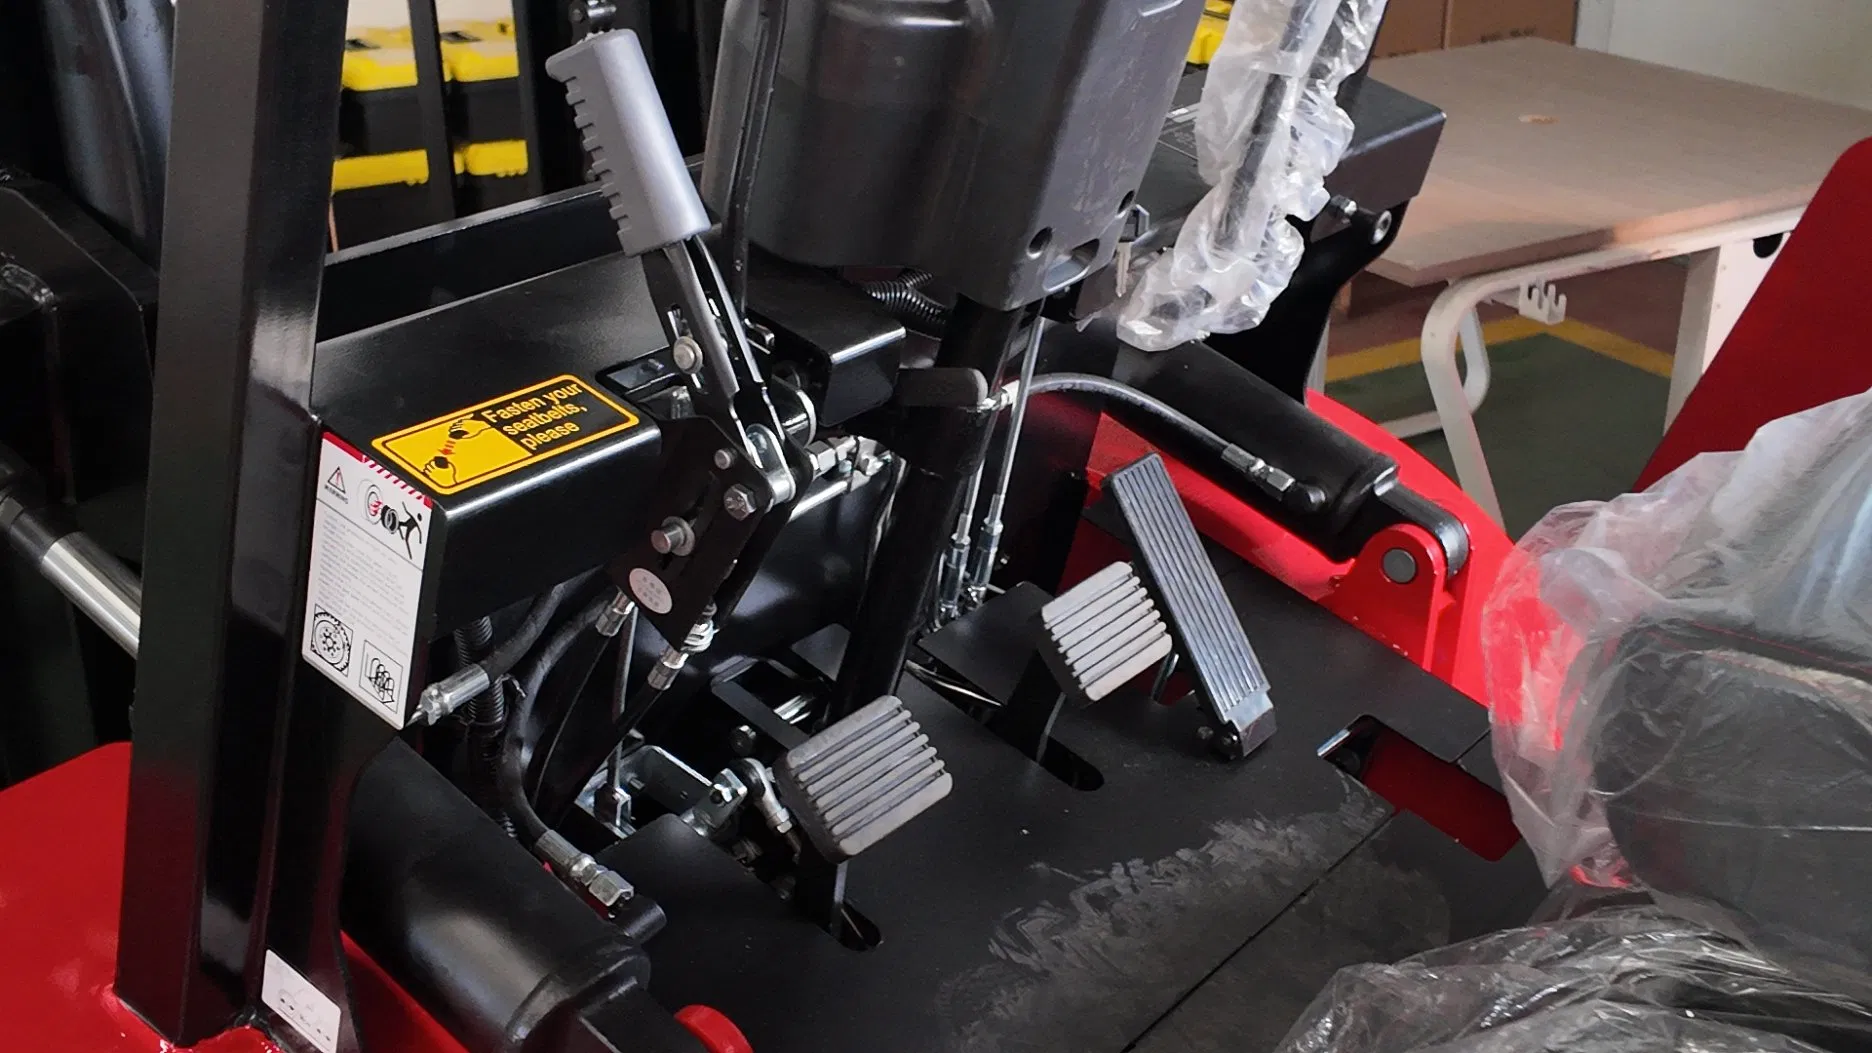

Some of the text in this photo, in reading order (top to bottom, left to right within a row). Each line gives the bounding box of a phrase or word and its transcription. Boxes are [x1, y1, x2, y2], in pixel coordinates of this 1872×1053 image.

[481, 383, 583, 423] Fasten your
[503, 403, 588, 436] seatbelts,
[520, 422, 580, 450] please
